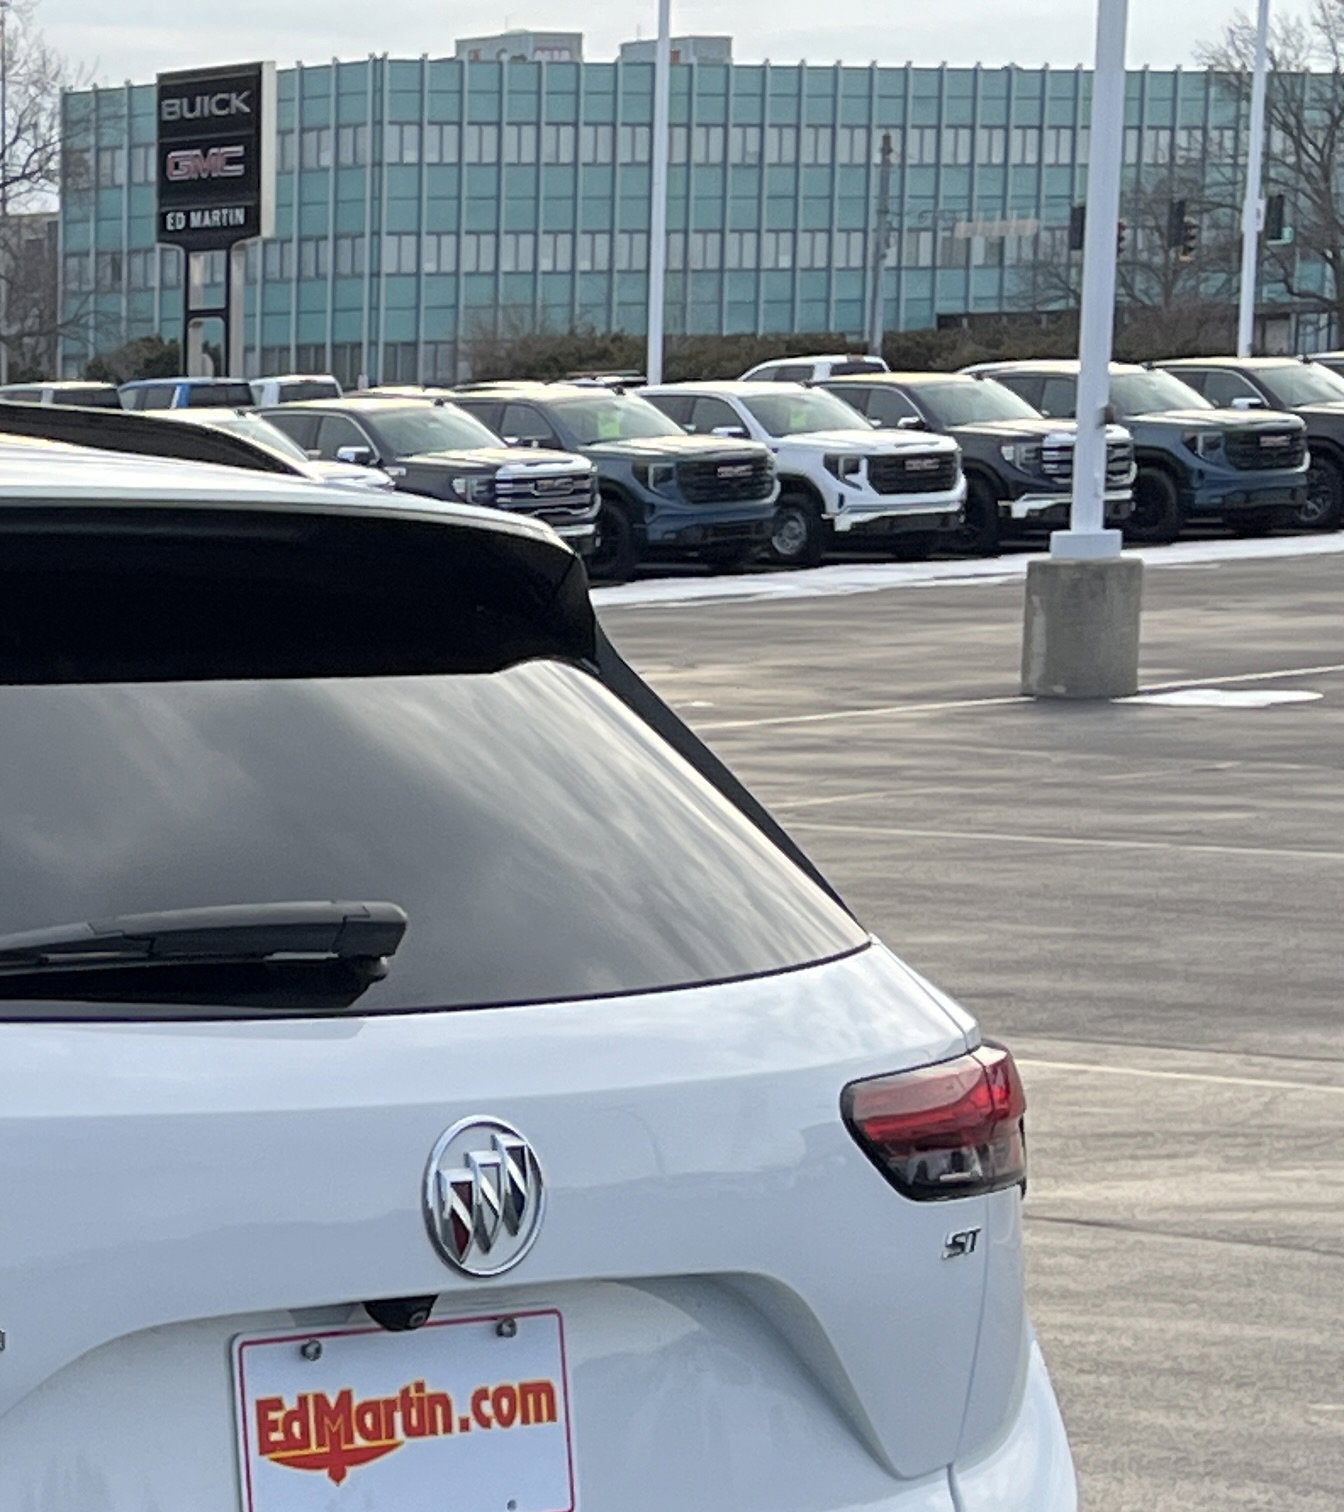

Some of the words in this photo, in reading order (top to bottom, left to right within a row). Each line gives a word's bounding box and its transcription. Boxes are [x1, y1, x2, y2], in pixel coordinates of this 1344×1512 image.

[161, 91, 251, 121] BUICK
[166, 146, 245, 182] GMC
[166, 211, 185, 231] ED
[189, 207, 245, 229] MARTIN
[941, 1226, 982, 1261] ST
[255, 1379, 558, 1458] EdMartin.com
